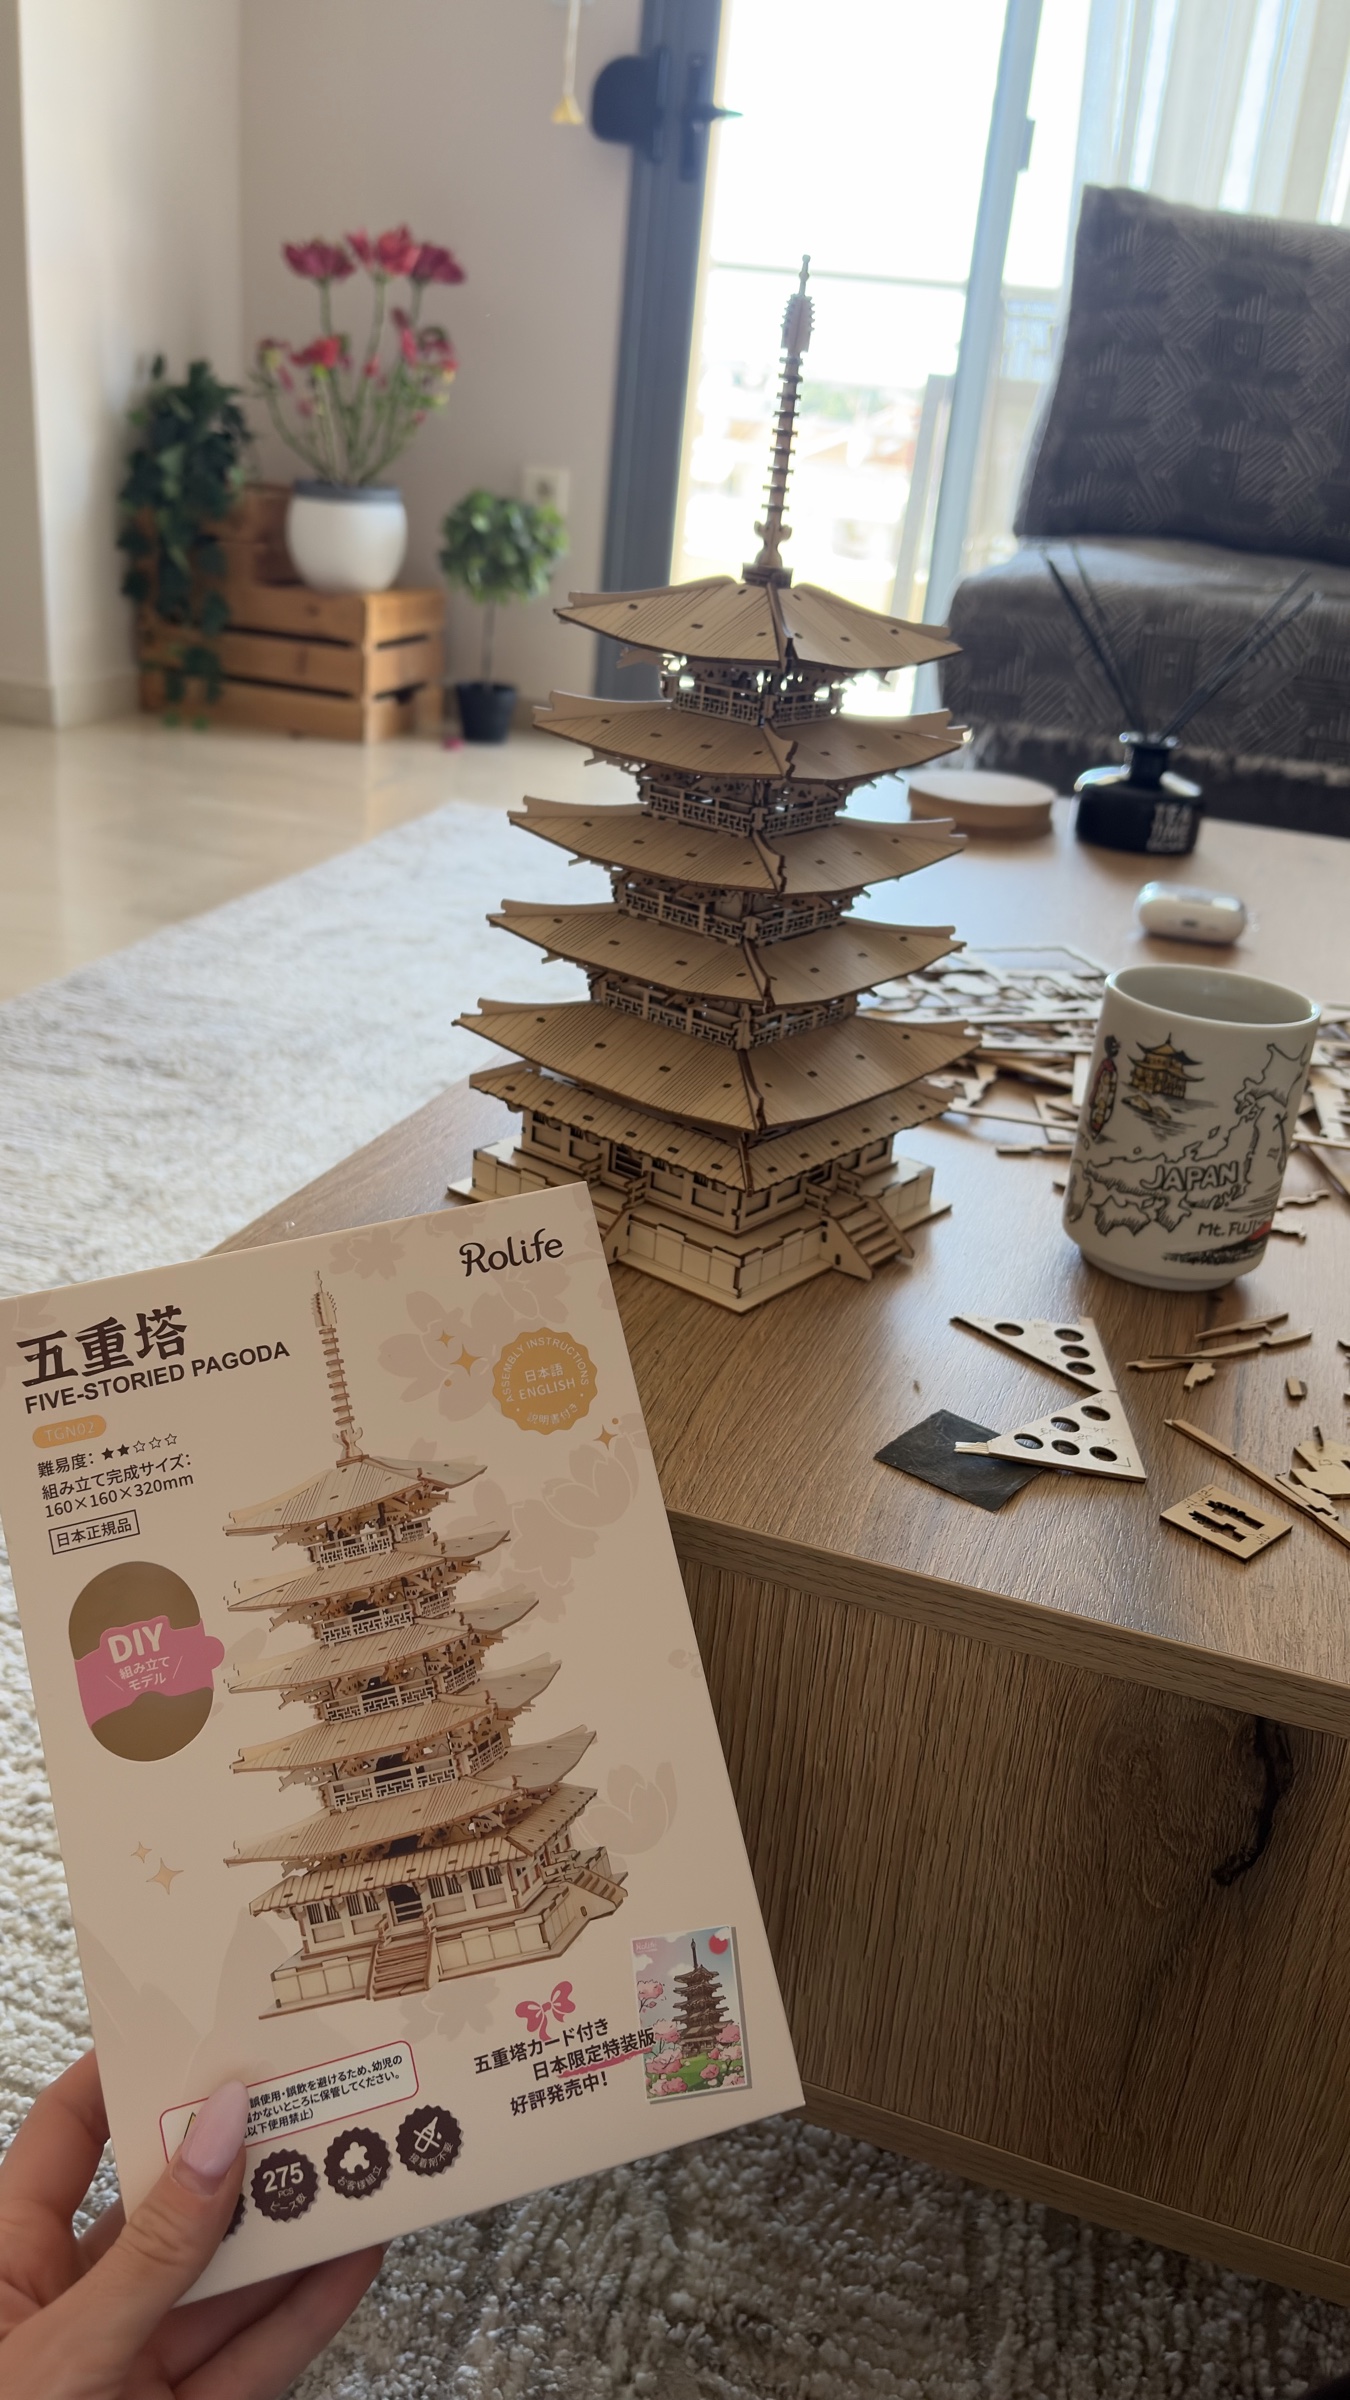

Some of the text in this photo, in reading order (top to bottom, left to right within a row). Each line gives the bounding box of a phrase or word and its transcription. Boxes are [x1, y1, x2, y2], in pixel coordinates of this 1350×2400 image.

[1139, 1160, 1240, 1192] JAPAN
[1197, 1219, 1258, 1237] Mt. FUJI
[459, 1228, 564, 1277] Rolife
[16, 1305, 187, 1387] 五重塔
[24, 1340, 290, 1414] FIVE-STORIED PAGODA
[501, 1337, 589, 1403] ASSEMBLY INSTRUCTIONS
[518, 1377, 576, 1400] ENGLISH
[524, 1362, 564, 1383] 日本語
[45, 1422, 96, 1442] TGN02
[41, 1453, 191, 1501] 組み立て完成サイズ：
[45, 1473, 194, 1518] 160×160×320mm
[56, 1517, 132, 1548] 日本正規品
[107, 1622, 163, 1664] DIY
[119, 1656, 170, 1680] 組み立て
[128, 1673, 166, 1691] モデル
[473, 2018, 609, 2074] 五重塔カード付き
[532, 2027, 657, 2081] 日本限定特装版
[510, 2074, 609, 2116] 好評発売中！
[244, 2107, 314, 2139] 以下使用禁止）
[262, 2161, 304, 2193] 275
